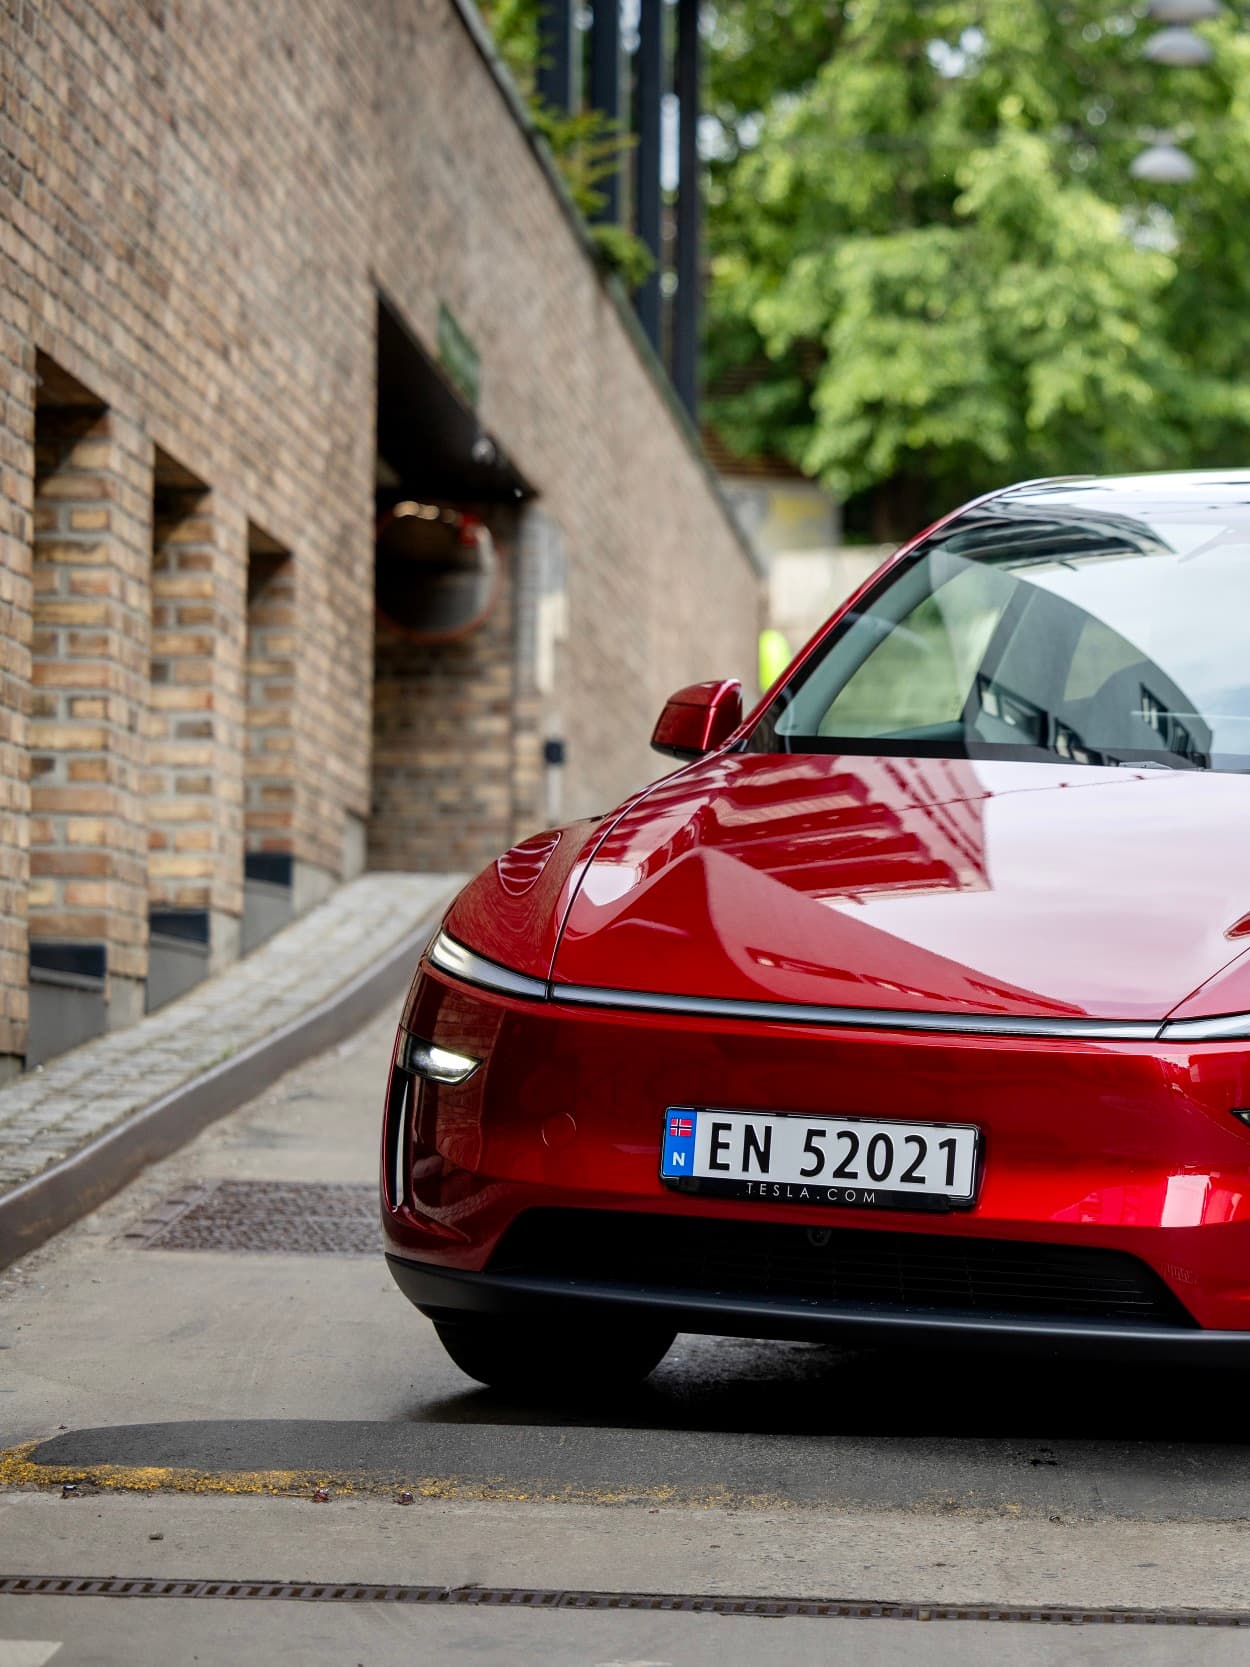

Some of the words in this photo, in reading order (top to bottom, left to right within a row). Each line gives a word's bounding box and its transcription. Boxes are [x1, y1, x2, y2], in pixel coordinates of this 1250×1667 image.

[672, 1151, 686, 1167] N
[707, 1121, 773, 1174] EN
[799, 1127, 958, 1187] 52021
[745, 1182, 877, 1205] TESLA.COM
